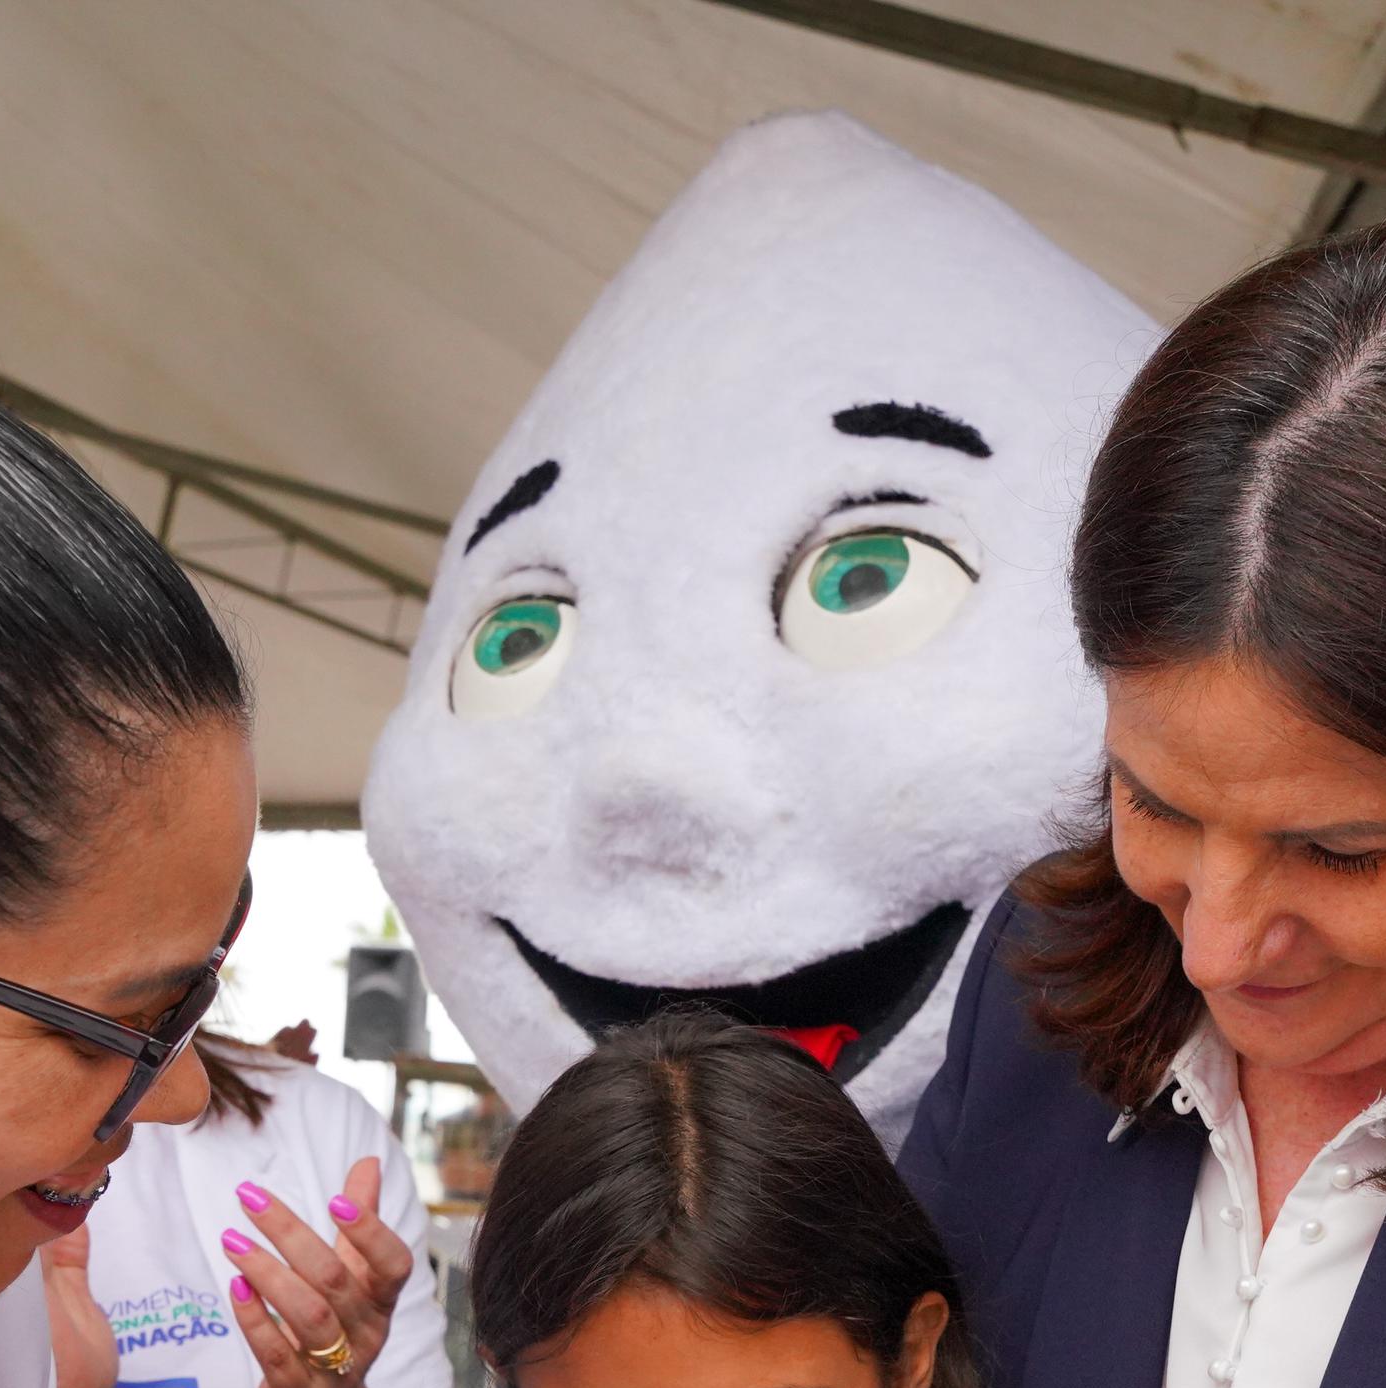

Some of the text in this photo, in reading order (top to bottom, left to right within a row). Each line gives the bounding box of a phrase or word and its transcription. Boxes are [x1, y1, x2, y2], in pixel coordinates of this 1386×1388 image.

[97, 1285, 219, 1319] VIMENTO
[110, 1301, 224, 1334] ONAL PELA
[117, 1316, 230, 1356] INAÇÃO
